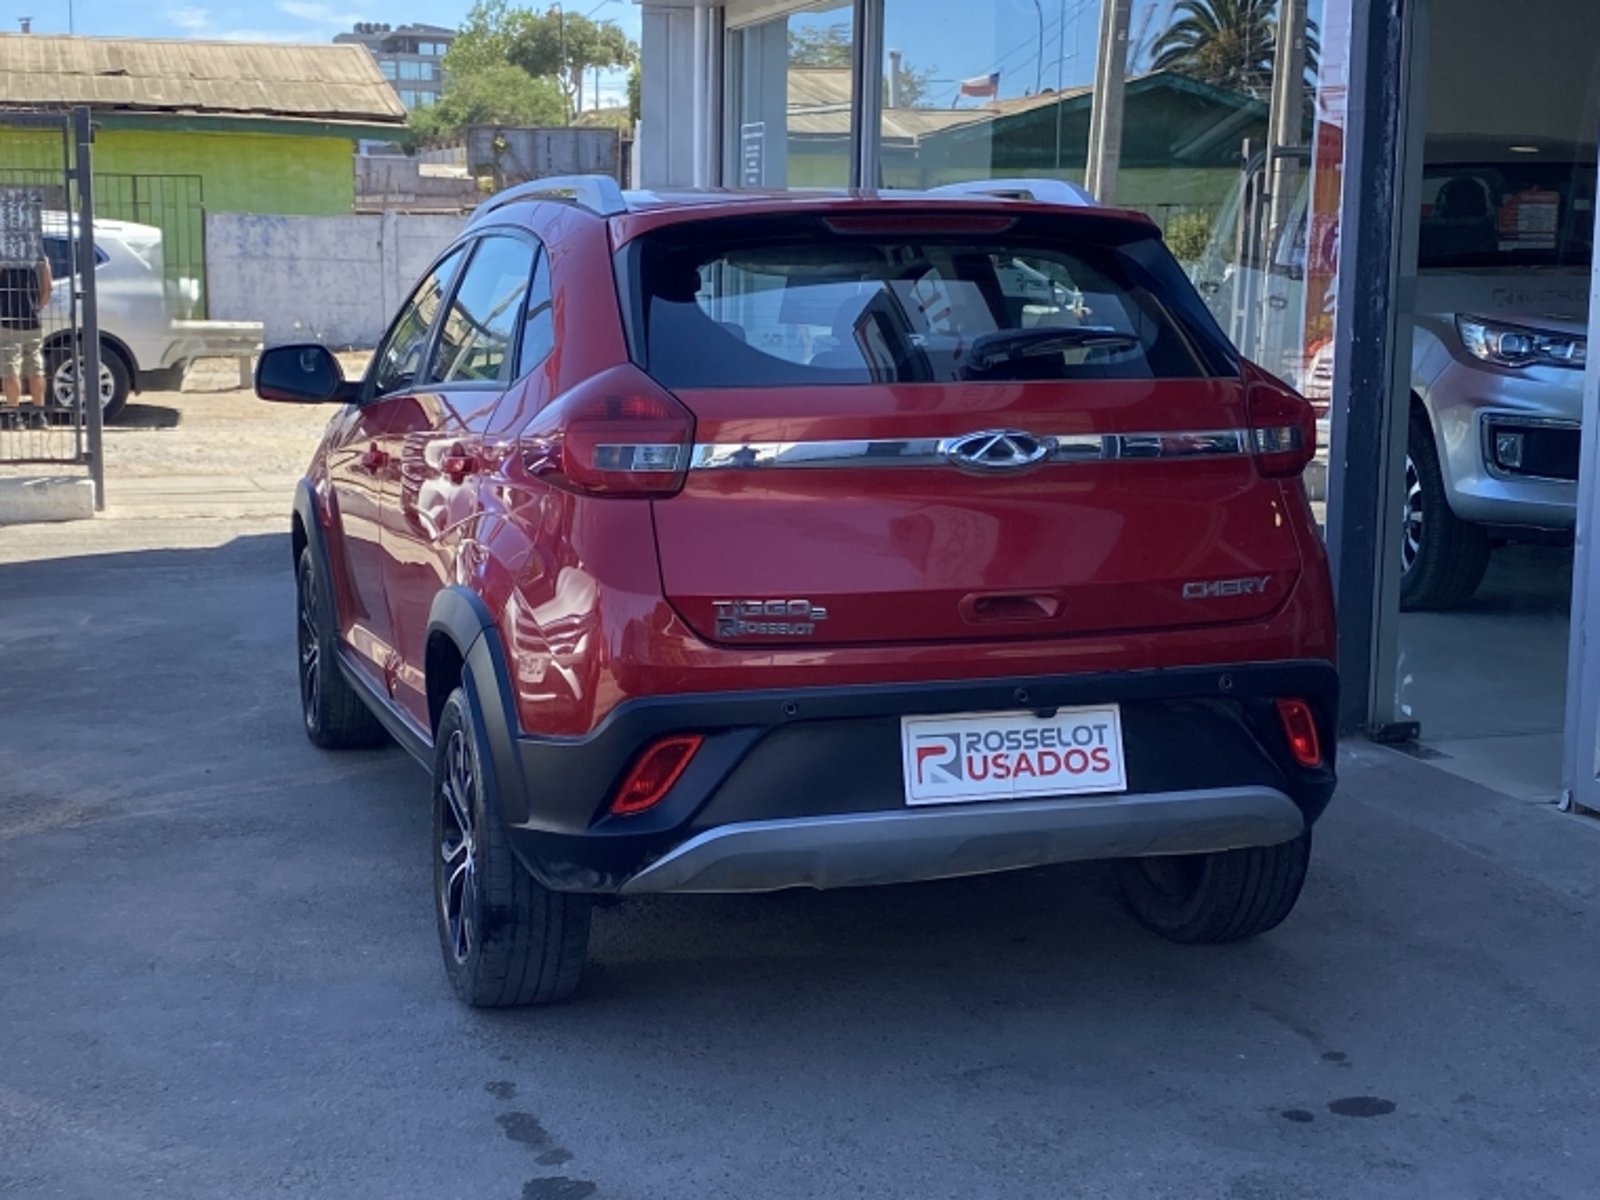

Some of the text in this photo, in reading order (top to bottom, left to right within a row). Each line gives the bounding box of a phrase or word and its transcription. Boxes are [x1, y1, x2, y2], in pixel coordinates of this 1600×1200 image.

[1183, 576, 1271, 599] CHERY
[966, 724, 1108, 753] ROSSELOT
[967, 747, 1110, 781] USADOS
